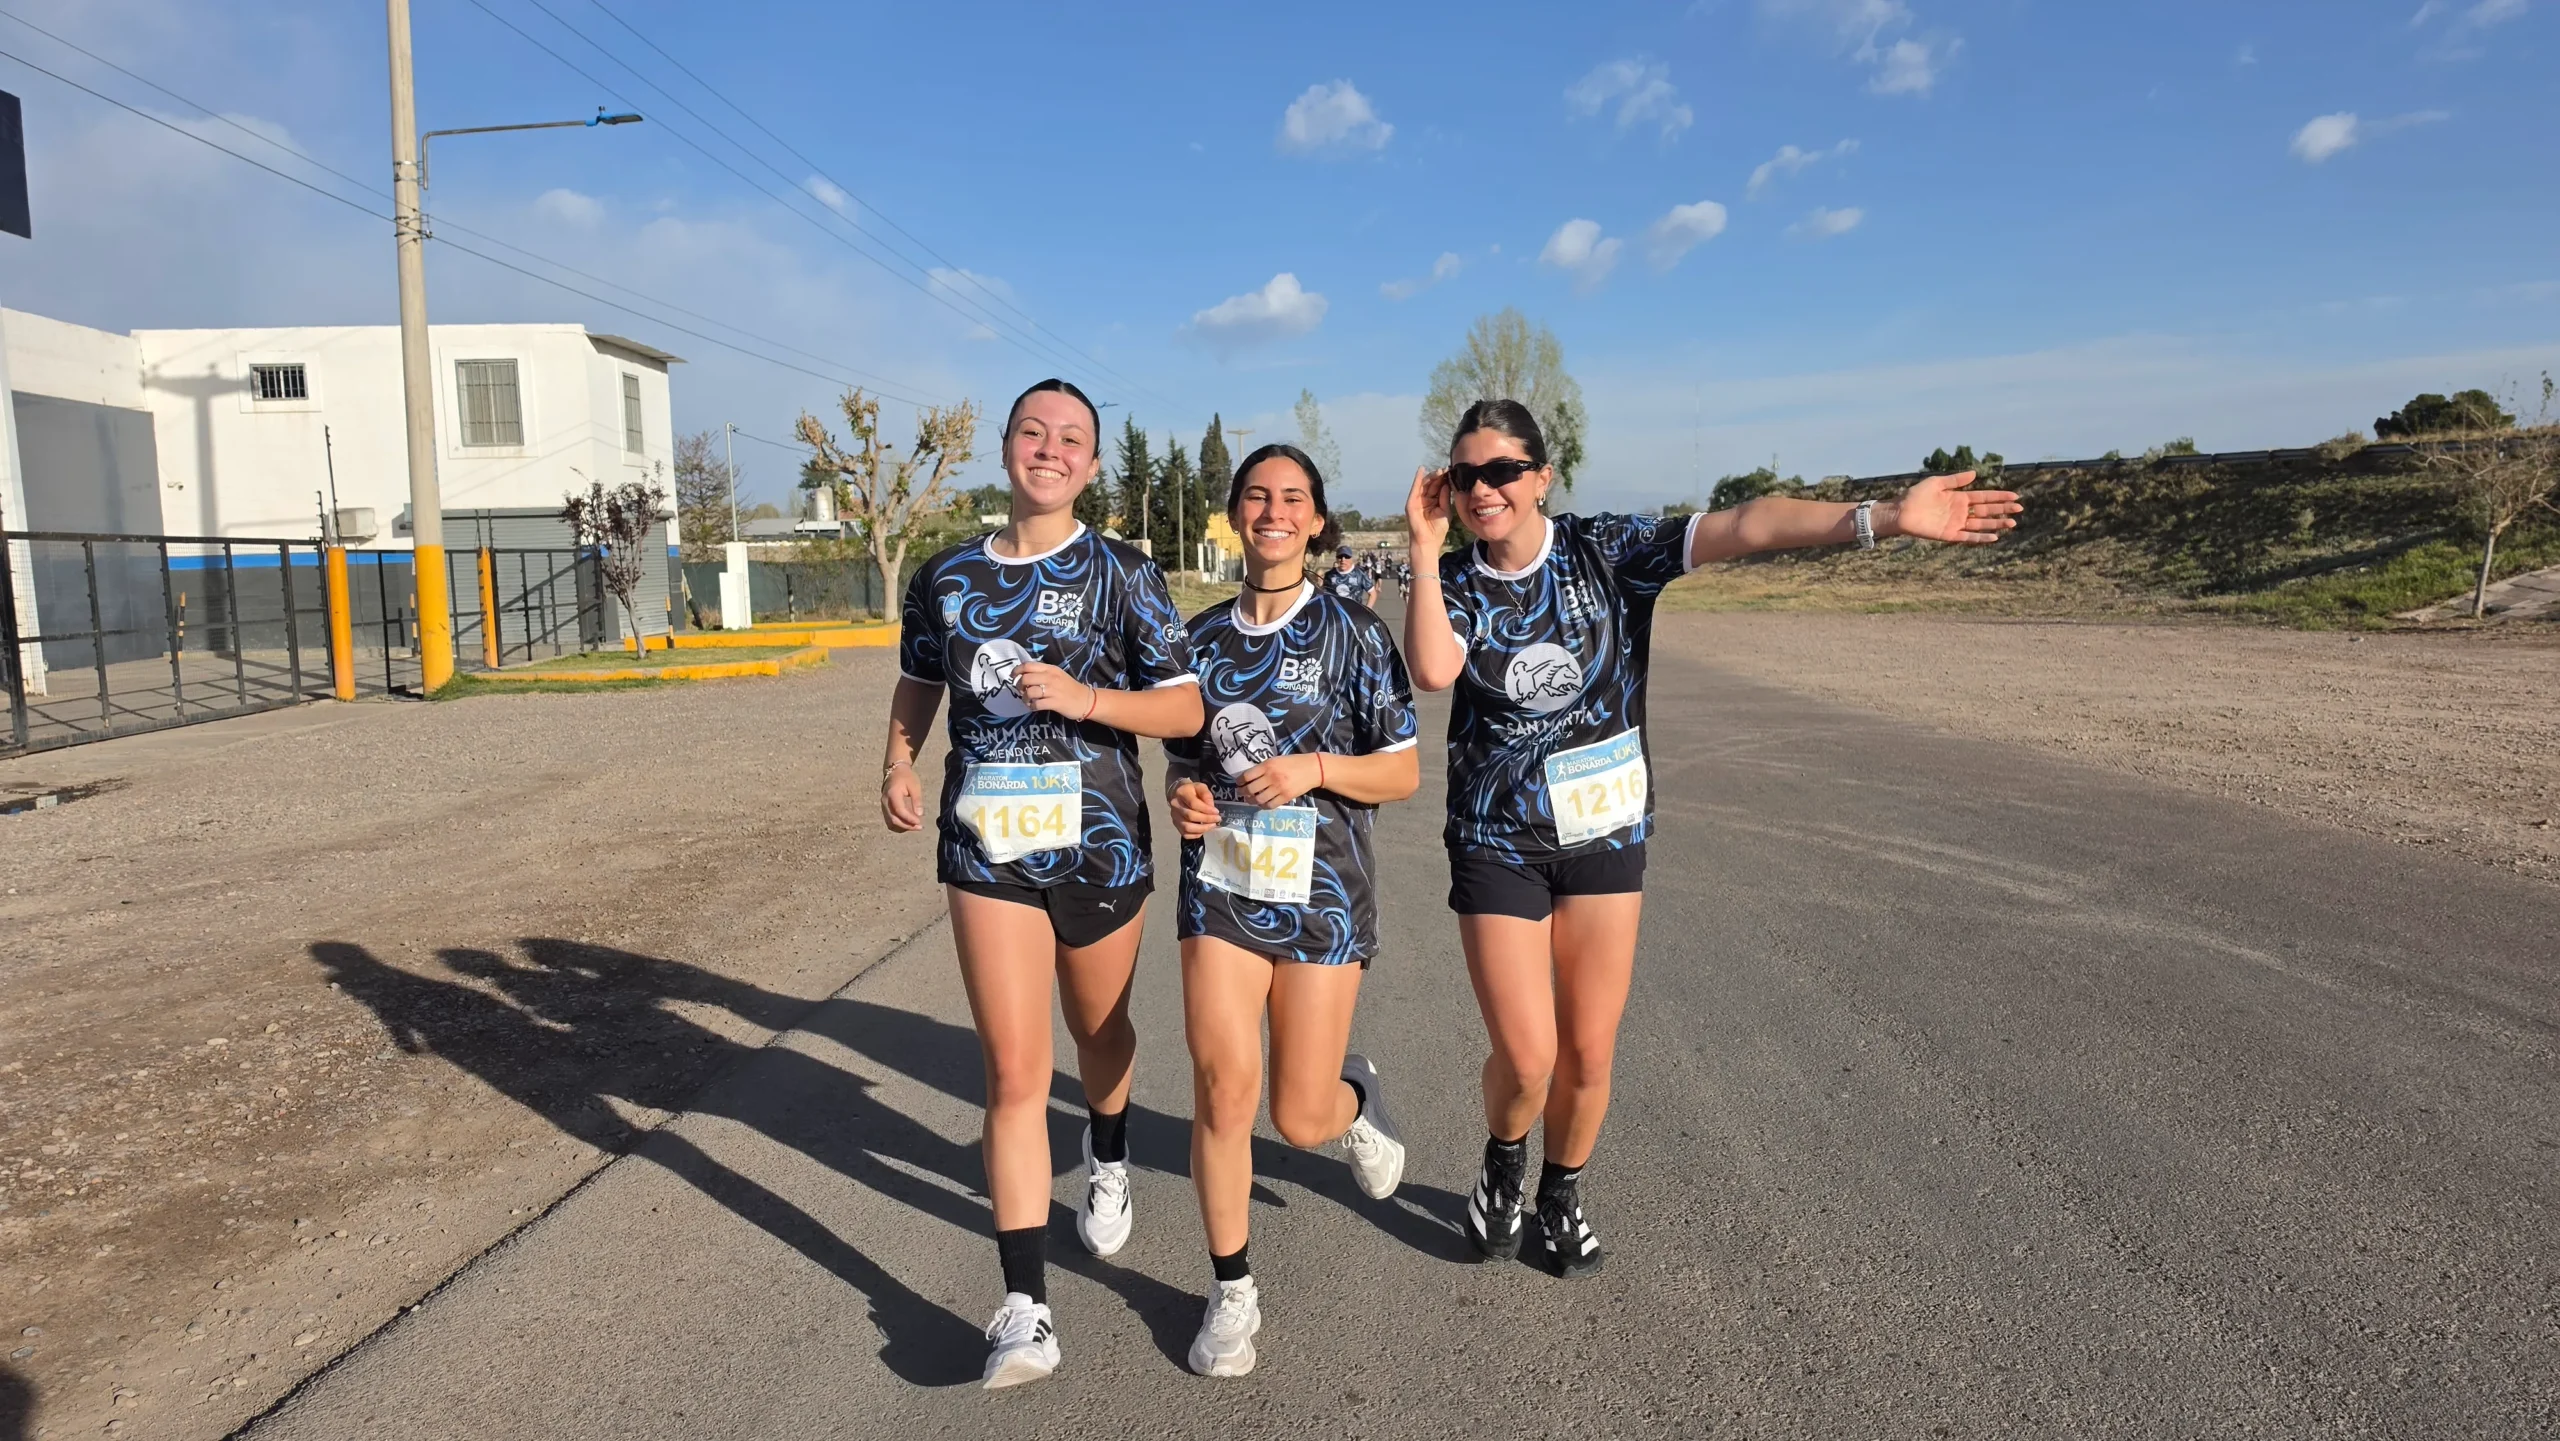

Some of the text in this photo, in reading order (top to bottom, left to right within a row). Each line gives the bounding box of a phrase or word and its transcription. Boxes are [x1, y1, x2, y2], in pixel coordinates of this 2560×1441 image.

[1035, 616, 1080, 630] BONARDA
[1276, 682, 1320, 693] BONARDA
[1506, 720, 1539, 736] SAN
[970, 729, 999, 744] SAN
[987, 745, 1051, 760] MENDOZA
[1567, 756, 1613, 774] BONARDA
[977, 774, 1060, 789] BONARDA 10K
[1567, 769, 1644, 819] 1216
[971, 803, 1067, 839] 1164
[1225, 817, 1296, 831] BONADA 10K
[1218, 837, 1299, 879] 1042
